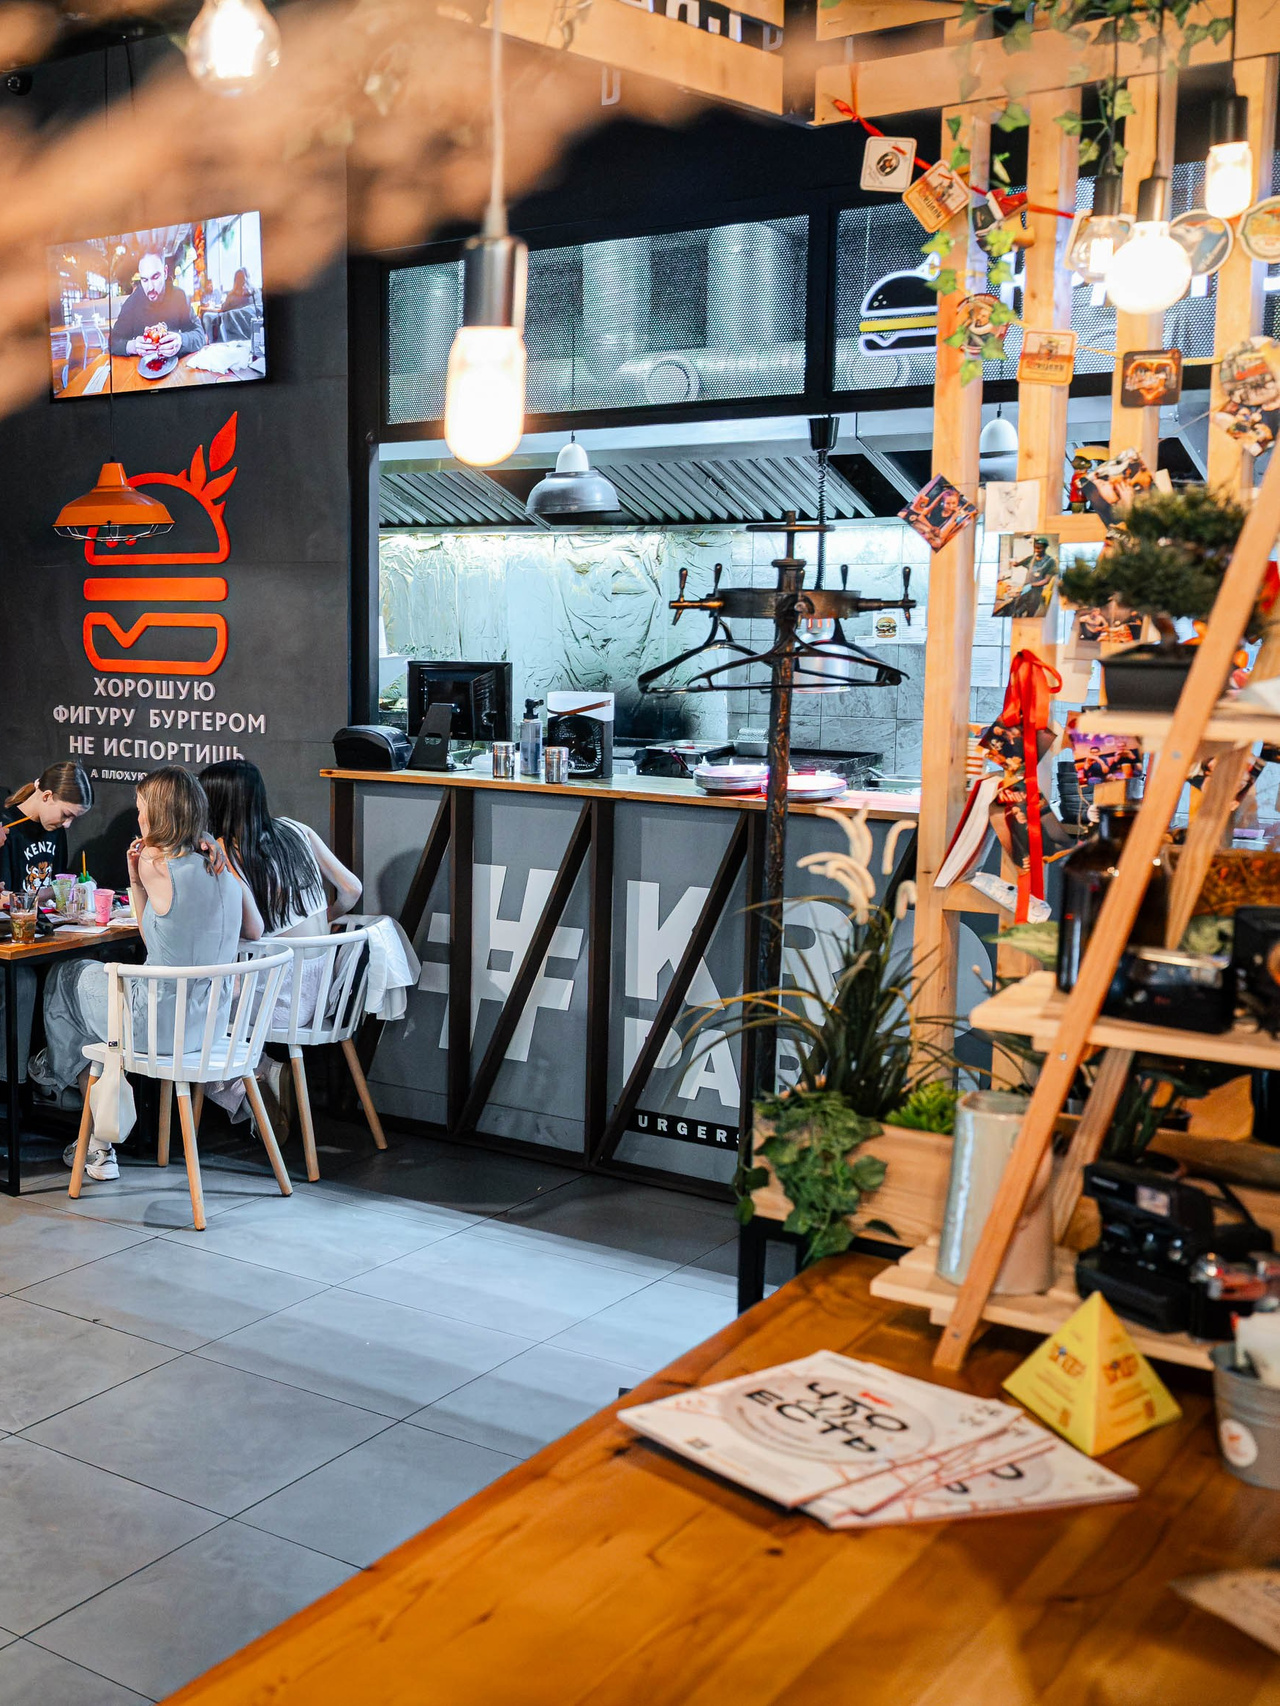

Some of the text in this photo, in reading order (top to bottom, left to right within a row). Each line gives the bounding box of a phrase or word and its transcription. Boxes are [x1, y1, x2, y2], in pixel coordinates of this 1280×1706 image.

[93, 677, 216, 701] ХОРОШУЮ
[52, 704, 267, 734] ФИГУРУ БУРГЕРОМ
[69, 735, 245, 764] НЕ ИСПОРТИШЬ
[90, 768, 99, 778] А
